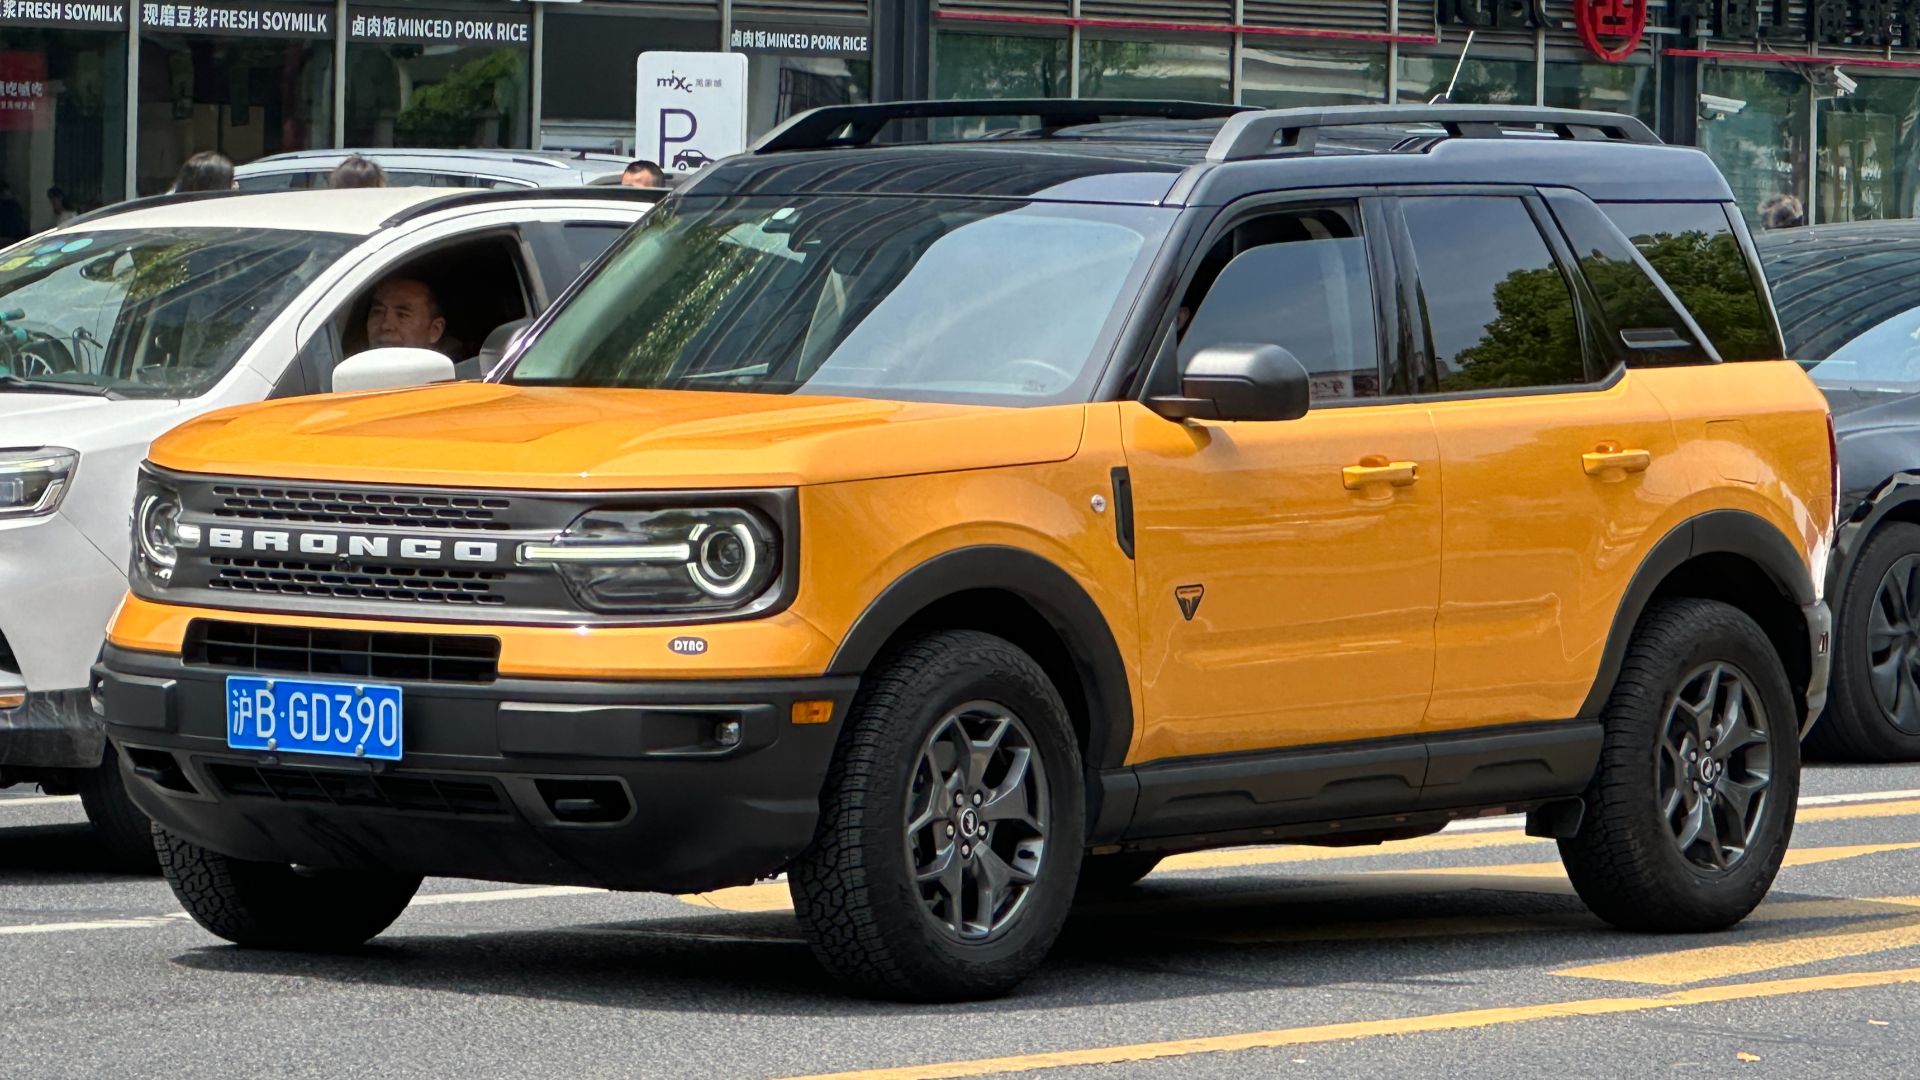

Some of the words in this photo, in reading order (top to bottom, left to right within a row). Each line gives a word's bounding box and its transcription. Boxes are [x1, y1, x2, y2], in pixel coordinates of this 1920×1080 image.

[18, 1, 61, 20] FRESH
[64, 3, 123, 23] SOYMILK
[143, 3, 208, 29] 现磨豆浆
[210, 9, 259, 30] FRESH
[262, 11, 327, 33] SOYMILK
[352, 14, 396, 38] 卤肉饭
[398, 18, 452, 39] MINCED
[455, 20, 494, 41] PORK
[496, 22, 528, 42] RICE
[731, 29, 766, 48] 卤肉饭
[766, 32, 809, 49] MINCED
[811, 34, 841, 51] PORK
[843, 36, 867, 52] RICE
[659, 108, 698, 169] P
[208, 527, 498, 562] BRONCO
[231, 688, 398, 748] 沪B·GD390
